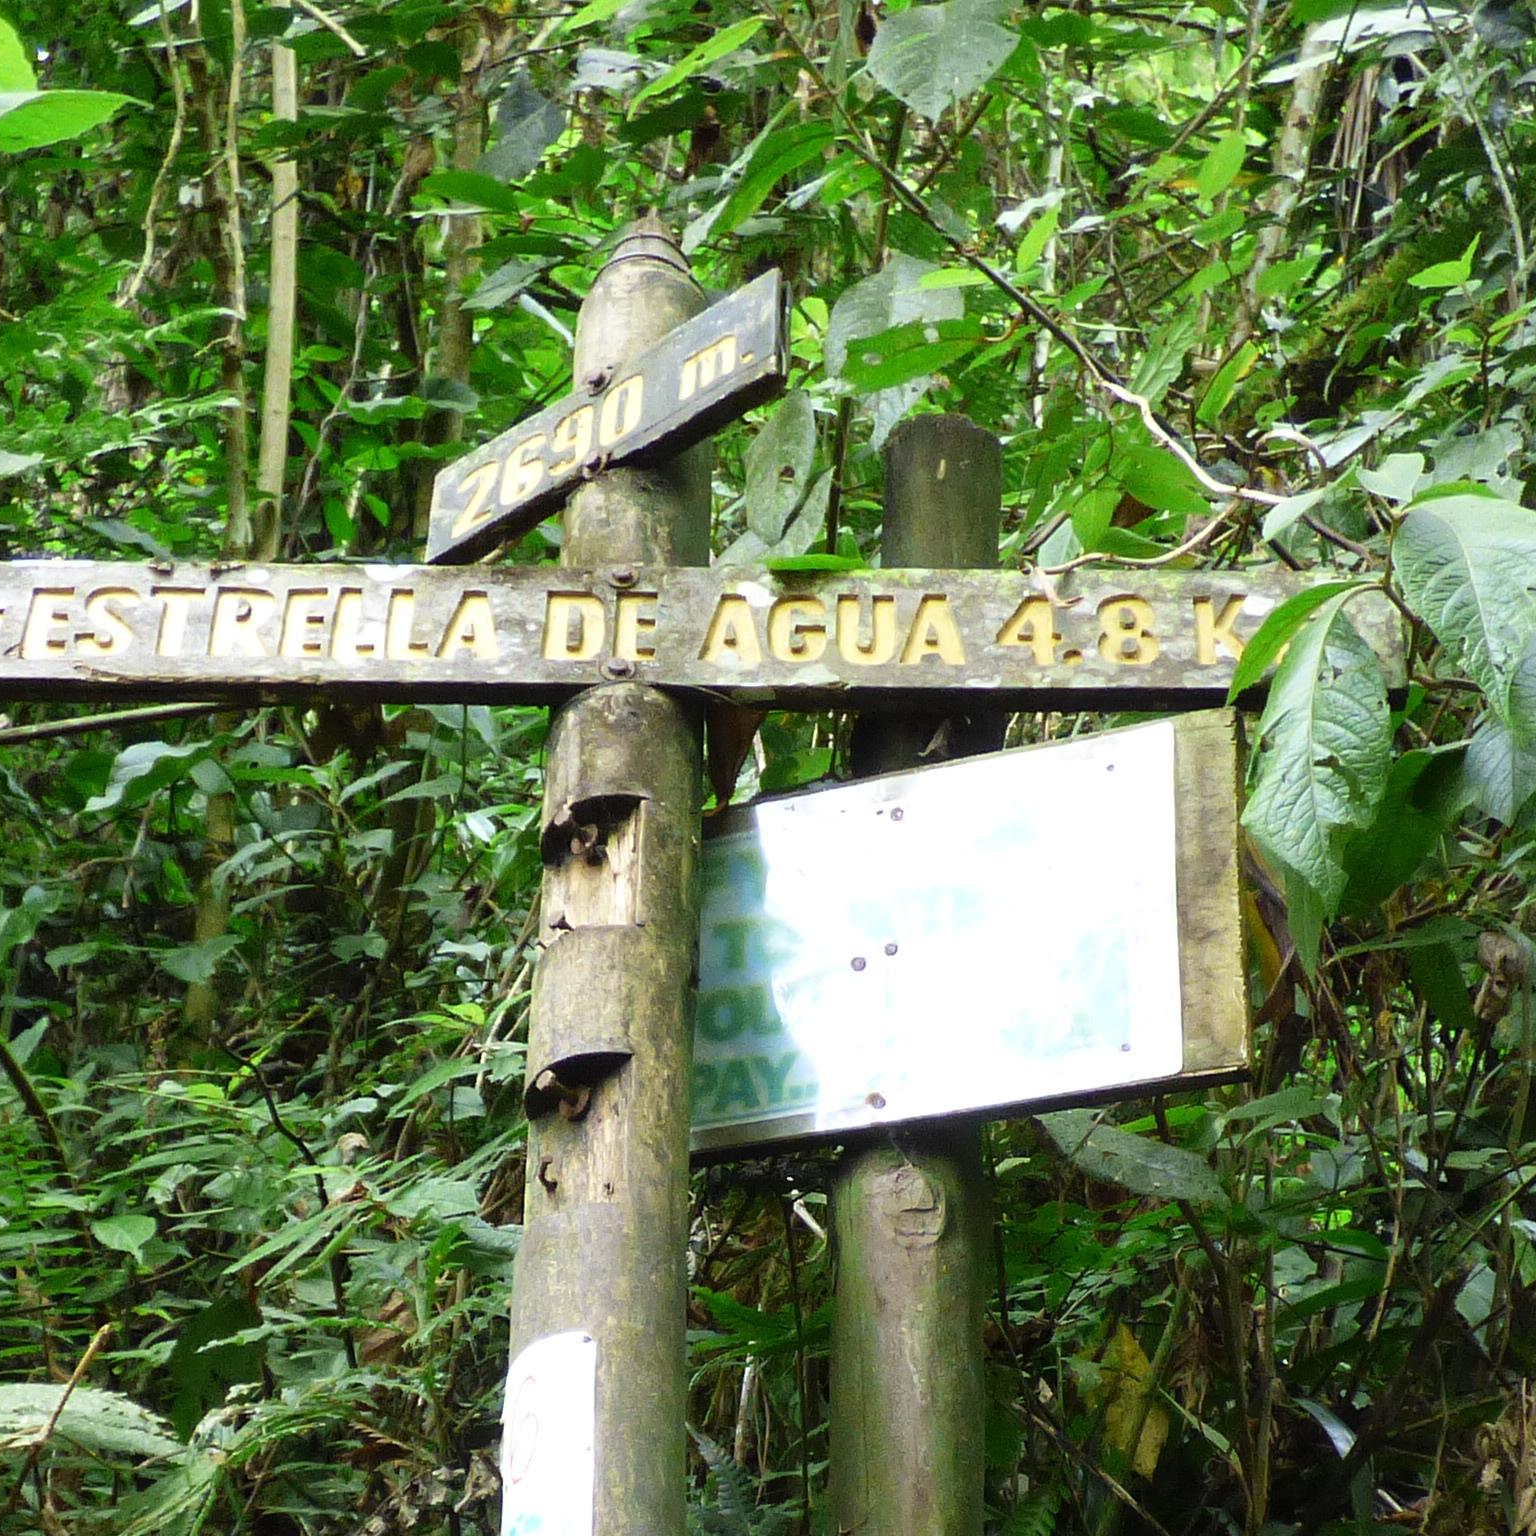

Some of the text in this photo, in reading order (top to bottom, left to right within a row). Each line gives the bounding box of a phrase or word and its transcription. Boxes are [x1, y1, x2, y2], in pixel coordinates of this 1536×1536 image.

[450, 375, 644, 539] 2690
[20, 586, 501, 661] ESTRELLA
[541, 590, 658, 662] DE
[698, 593, 966, 666] AGUA
